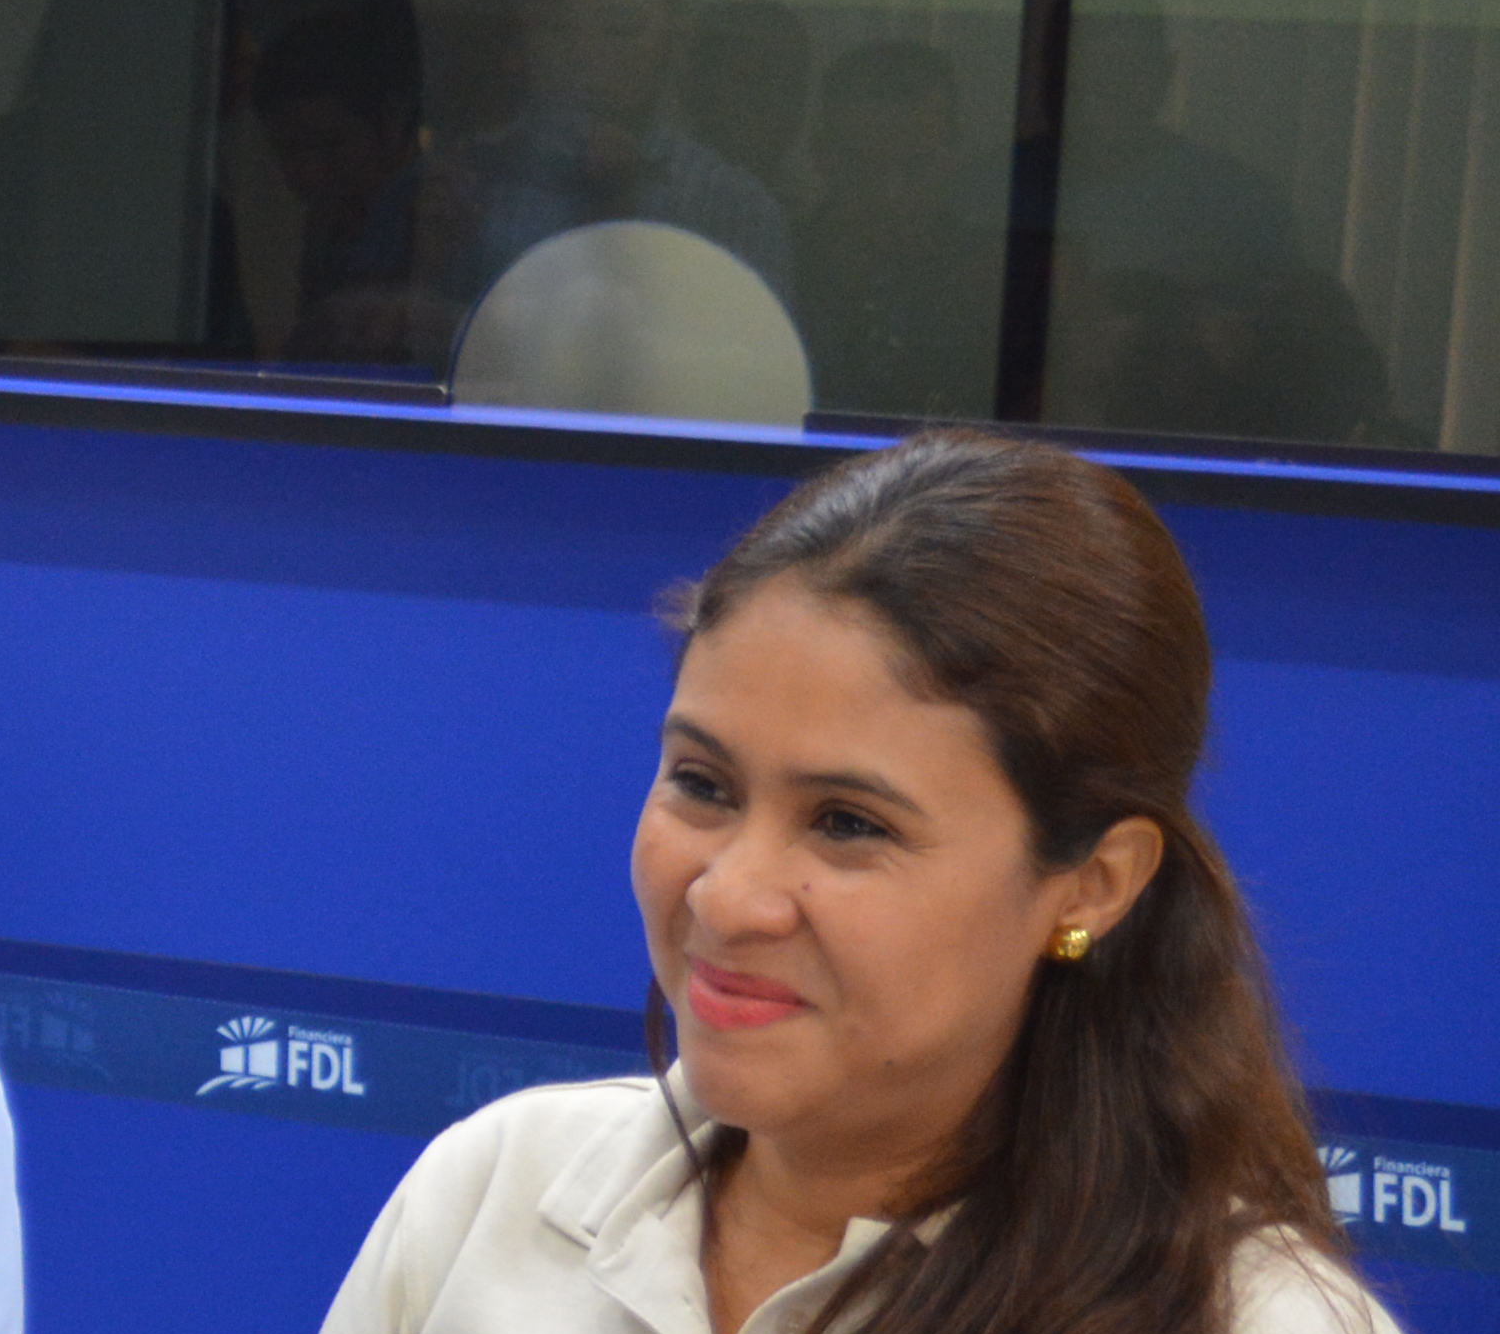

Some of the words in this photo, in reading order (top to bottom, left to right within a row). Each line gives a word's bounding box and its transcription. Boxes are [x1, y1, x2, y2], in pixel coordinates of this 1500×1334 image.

[288, 1025, 353, 1046] Financiera
[287, 1038, 366, 1096] FDL
[1373, 1155, 1451, 1179] Financiera
[1372, 1171, 1467, 1233] FDL
